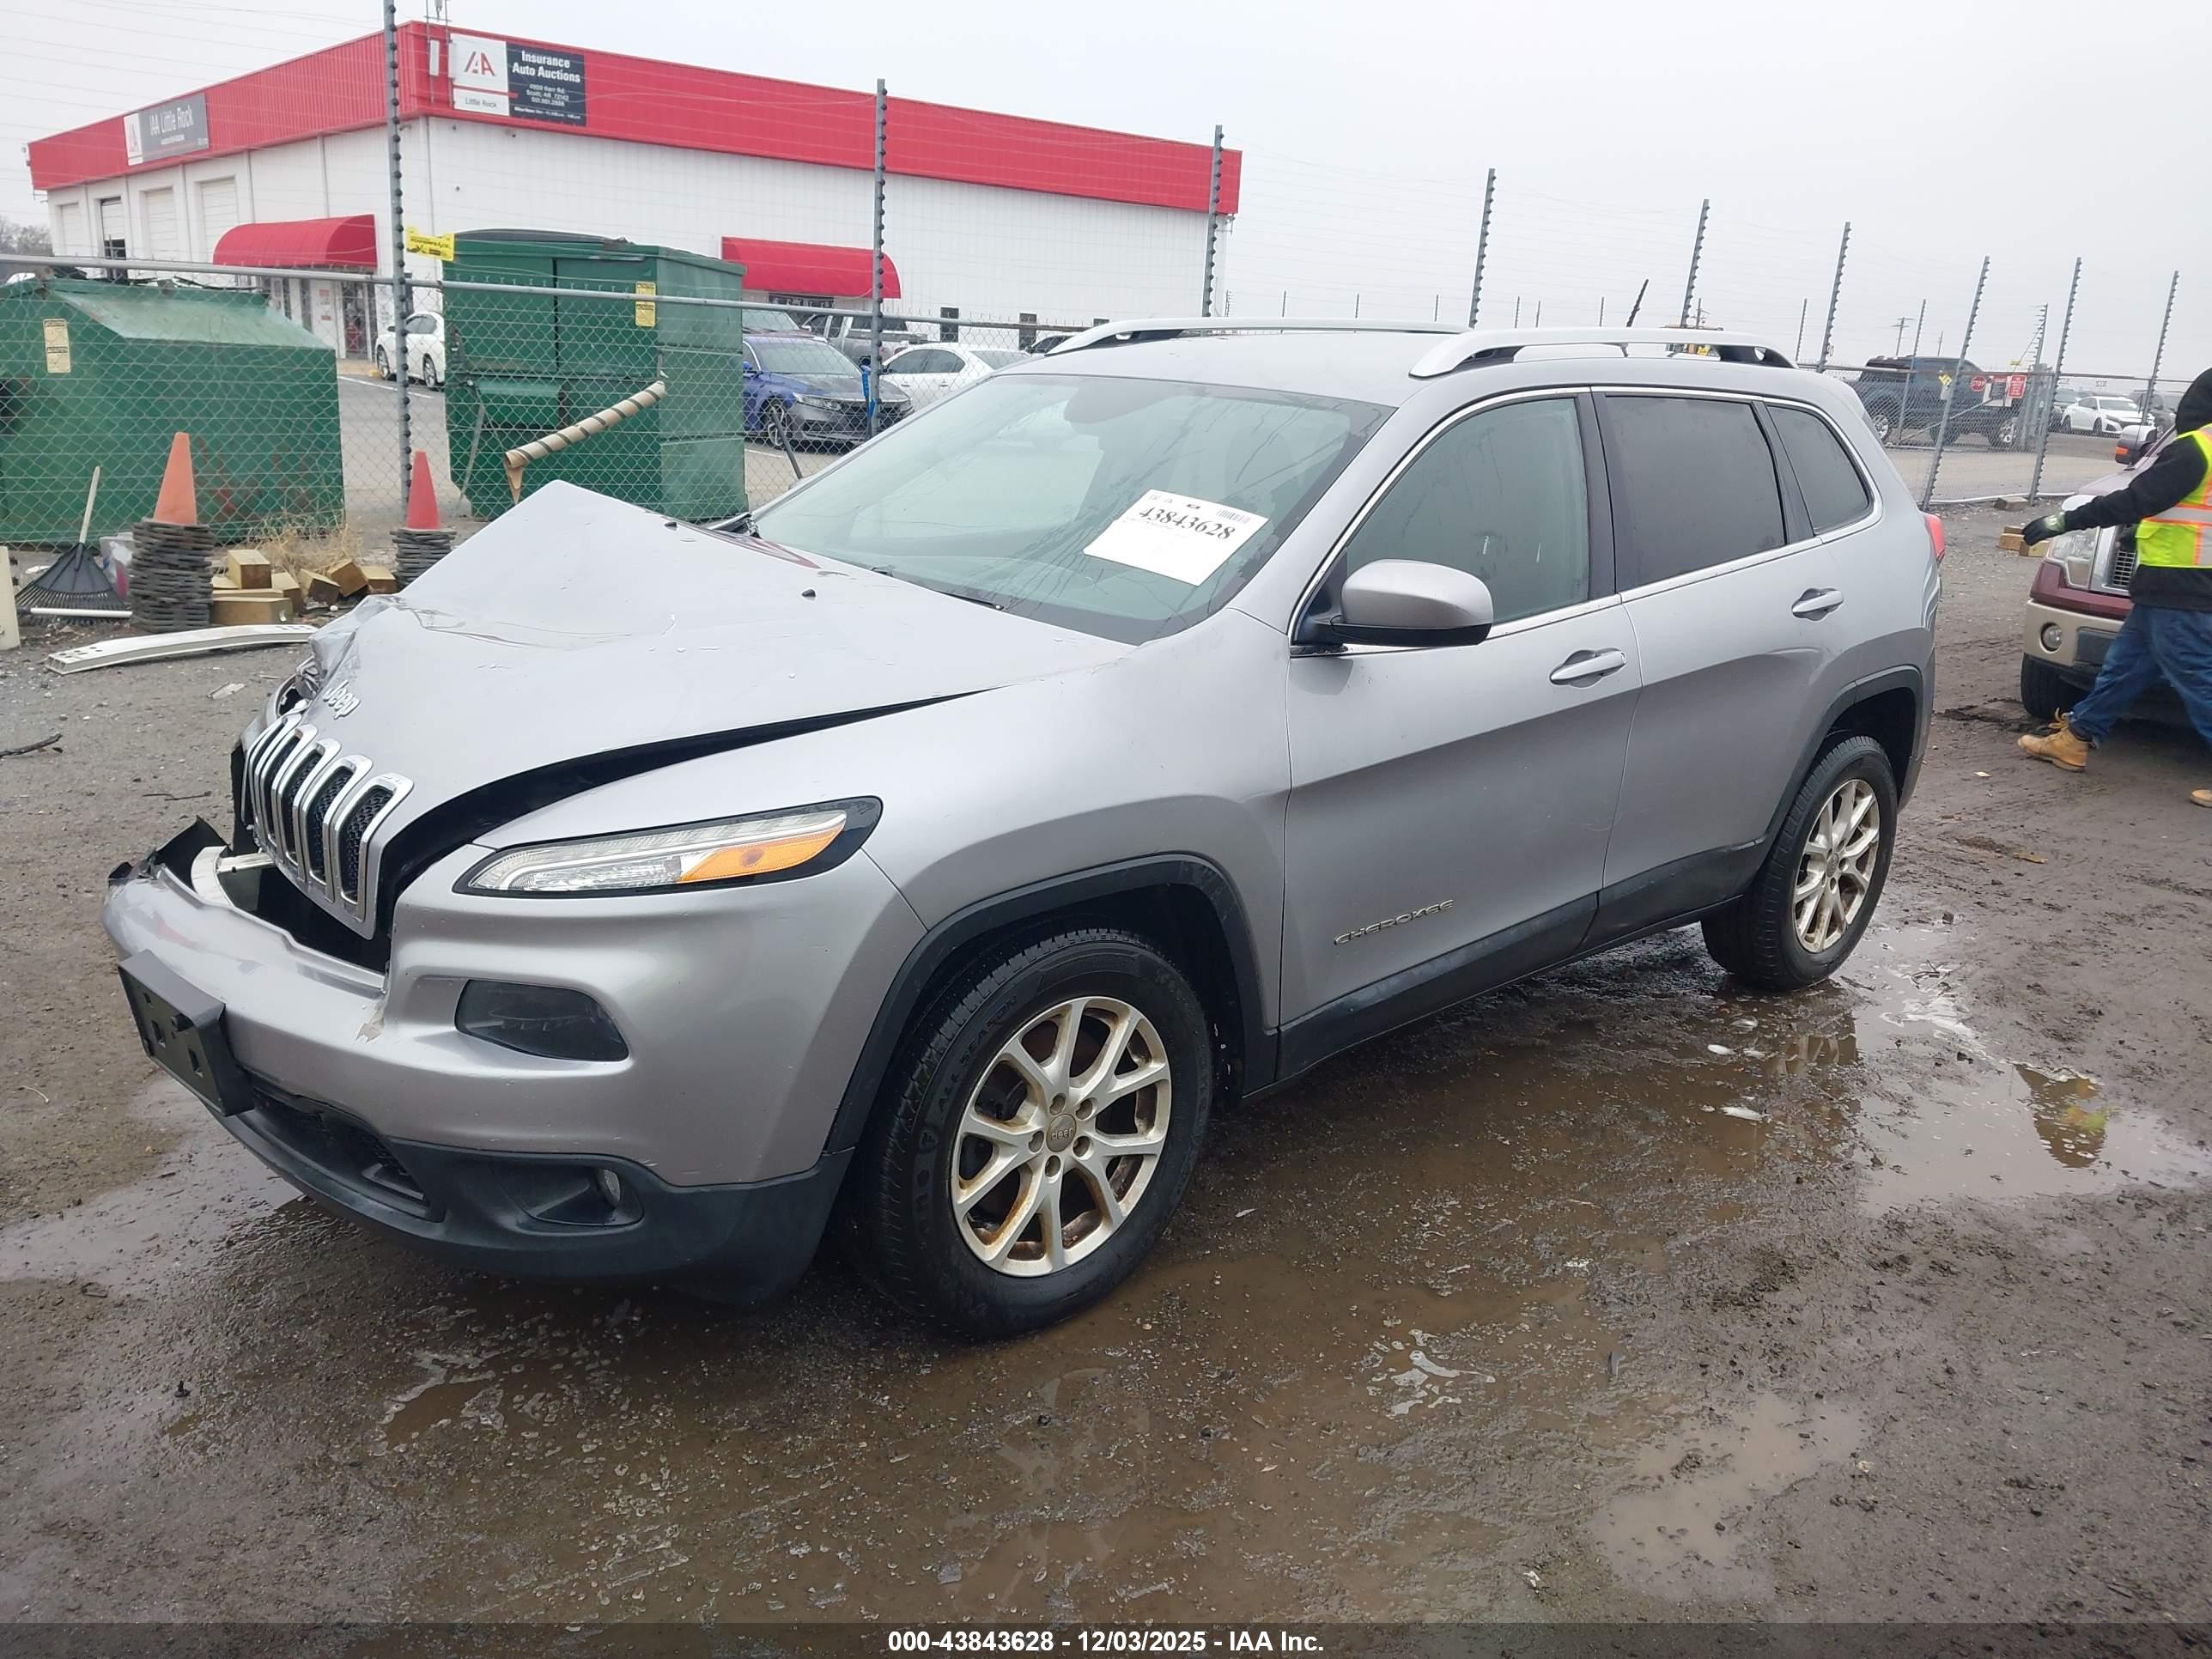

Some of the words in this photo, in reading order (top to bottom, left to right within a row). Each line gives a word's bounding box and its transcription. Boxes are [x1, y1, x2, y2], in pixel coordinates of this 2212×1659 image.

[512, 62, 535, 76] Auto
[538, 66, 581, 82] Auctions
[521, 50, 570, 68] Insurance
[160, 110, 177, 133] Little
[177, 104, 194, 129] Rock
[1139, 506, 1237, 540] 43843628
[323, 679, 362, 720] Jeep
[1334, 899, 1454, 945] CHEROKEE
